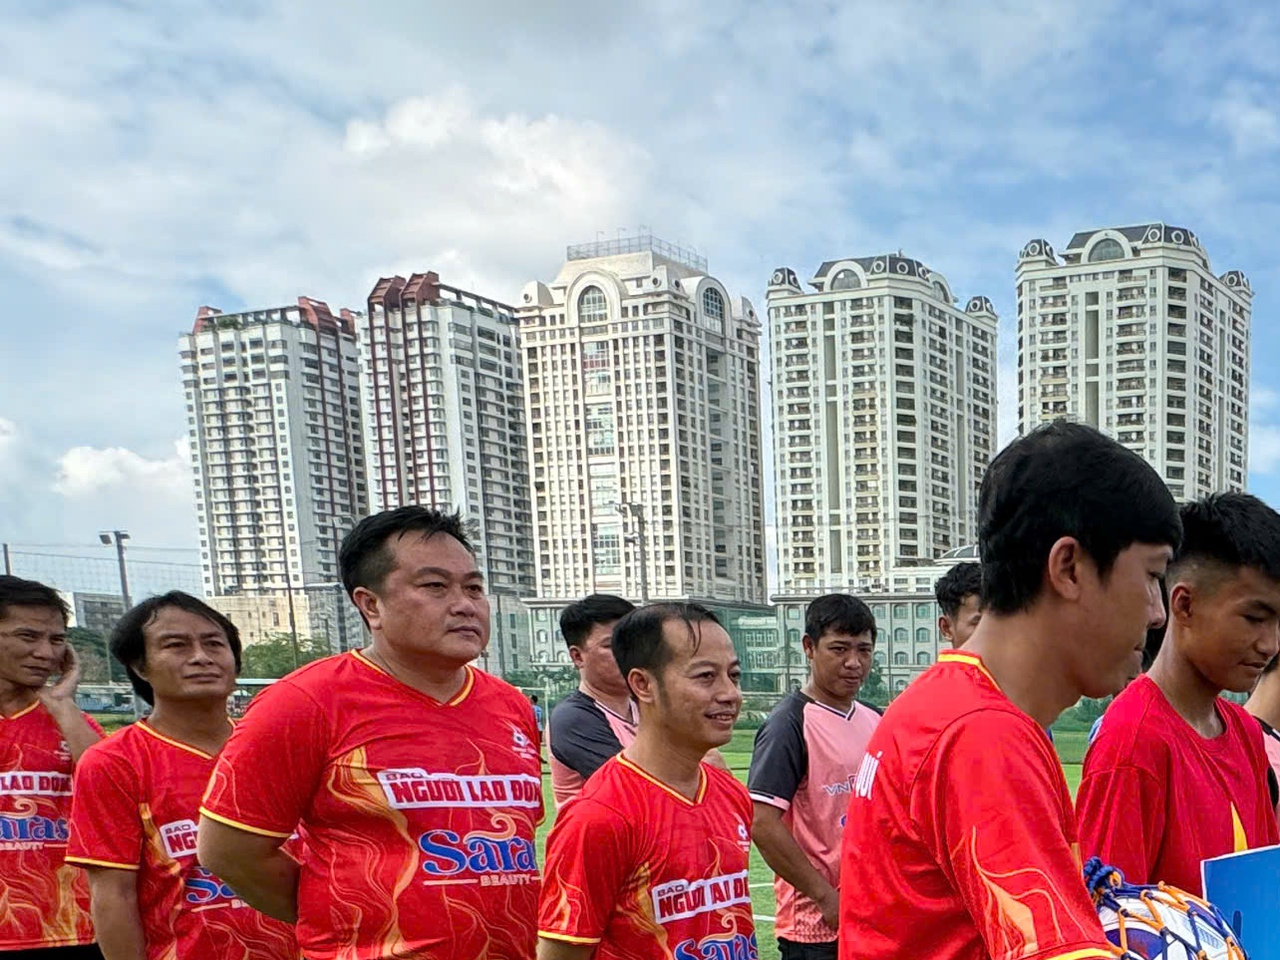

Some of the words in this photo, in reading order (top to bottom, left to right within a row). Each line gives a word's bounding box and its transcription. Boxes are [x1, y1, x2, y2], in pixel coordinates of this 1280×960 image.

[467, 780, 507, 802] LAO
[418, 829, 537, 876] Sara
[480, 873, 531, 887] BEAUTY
